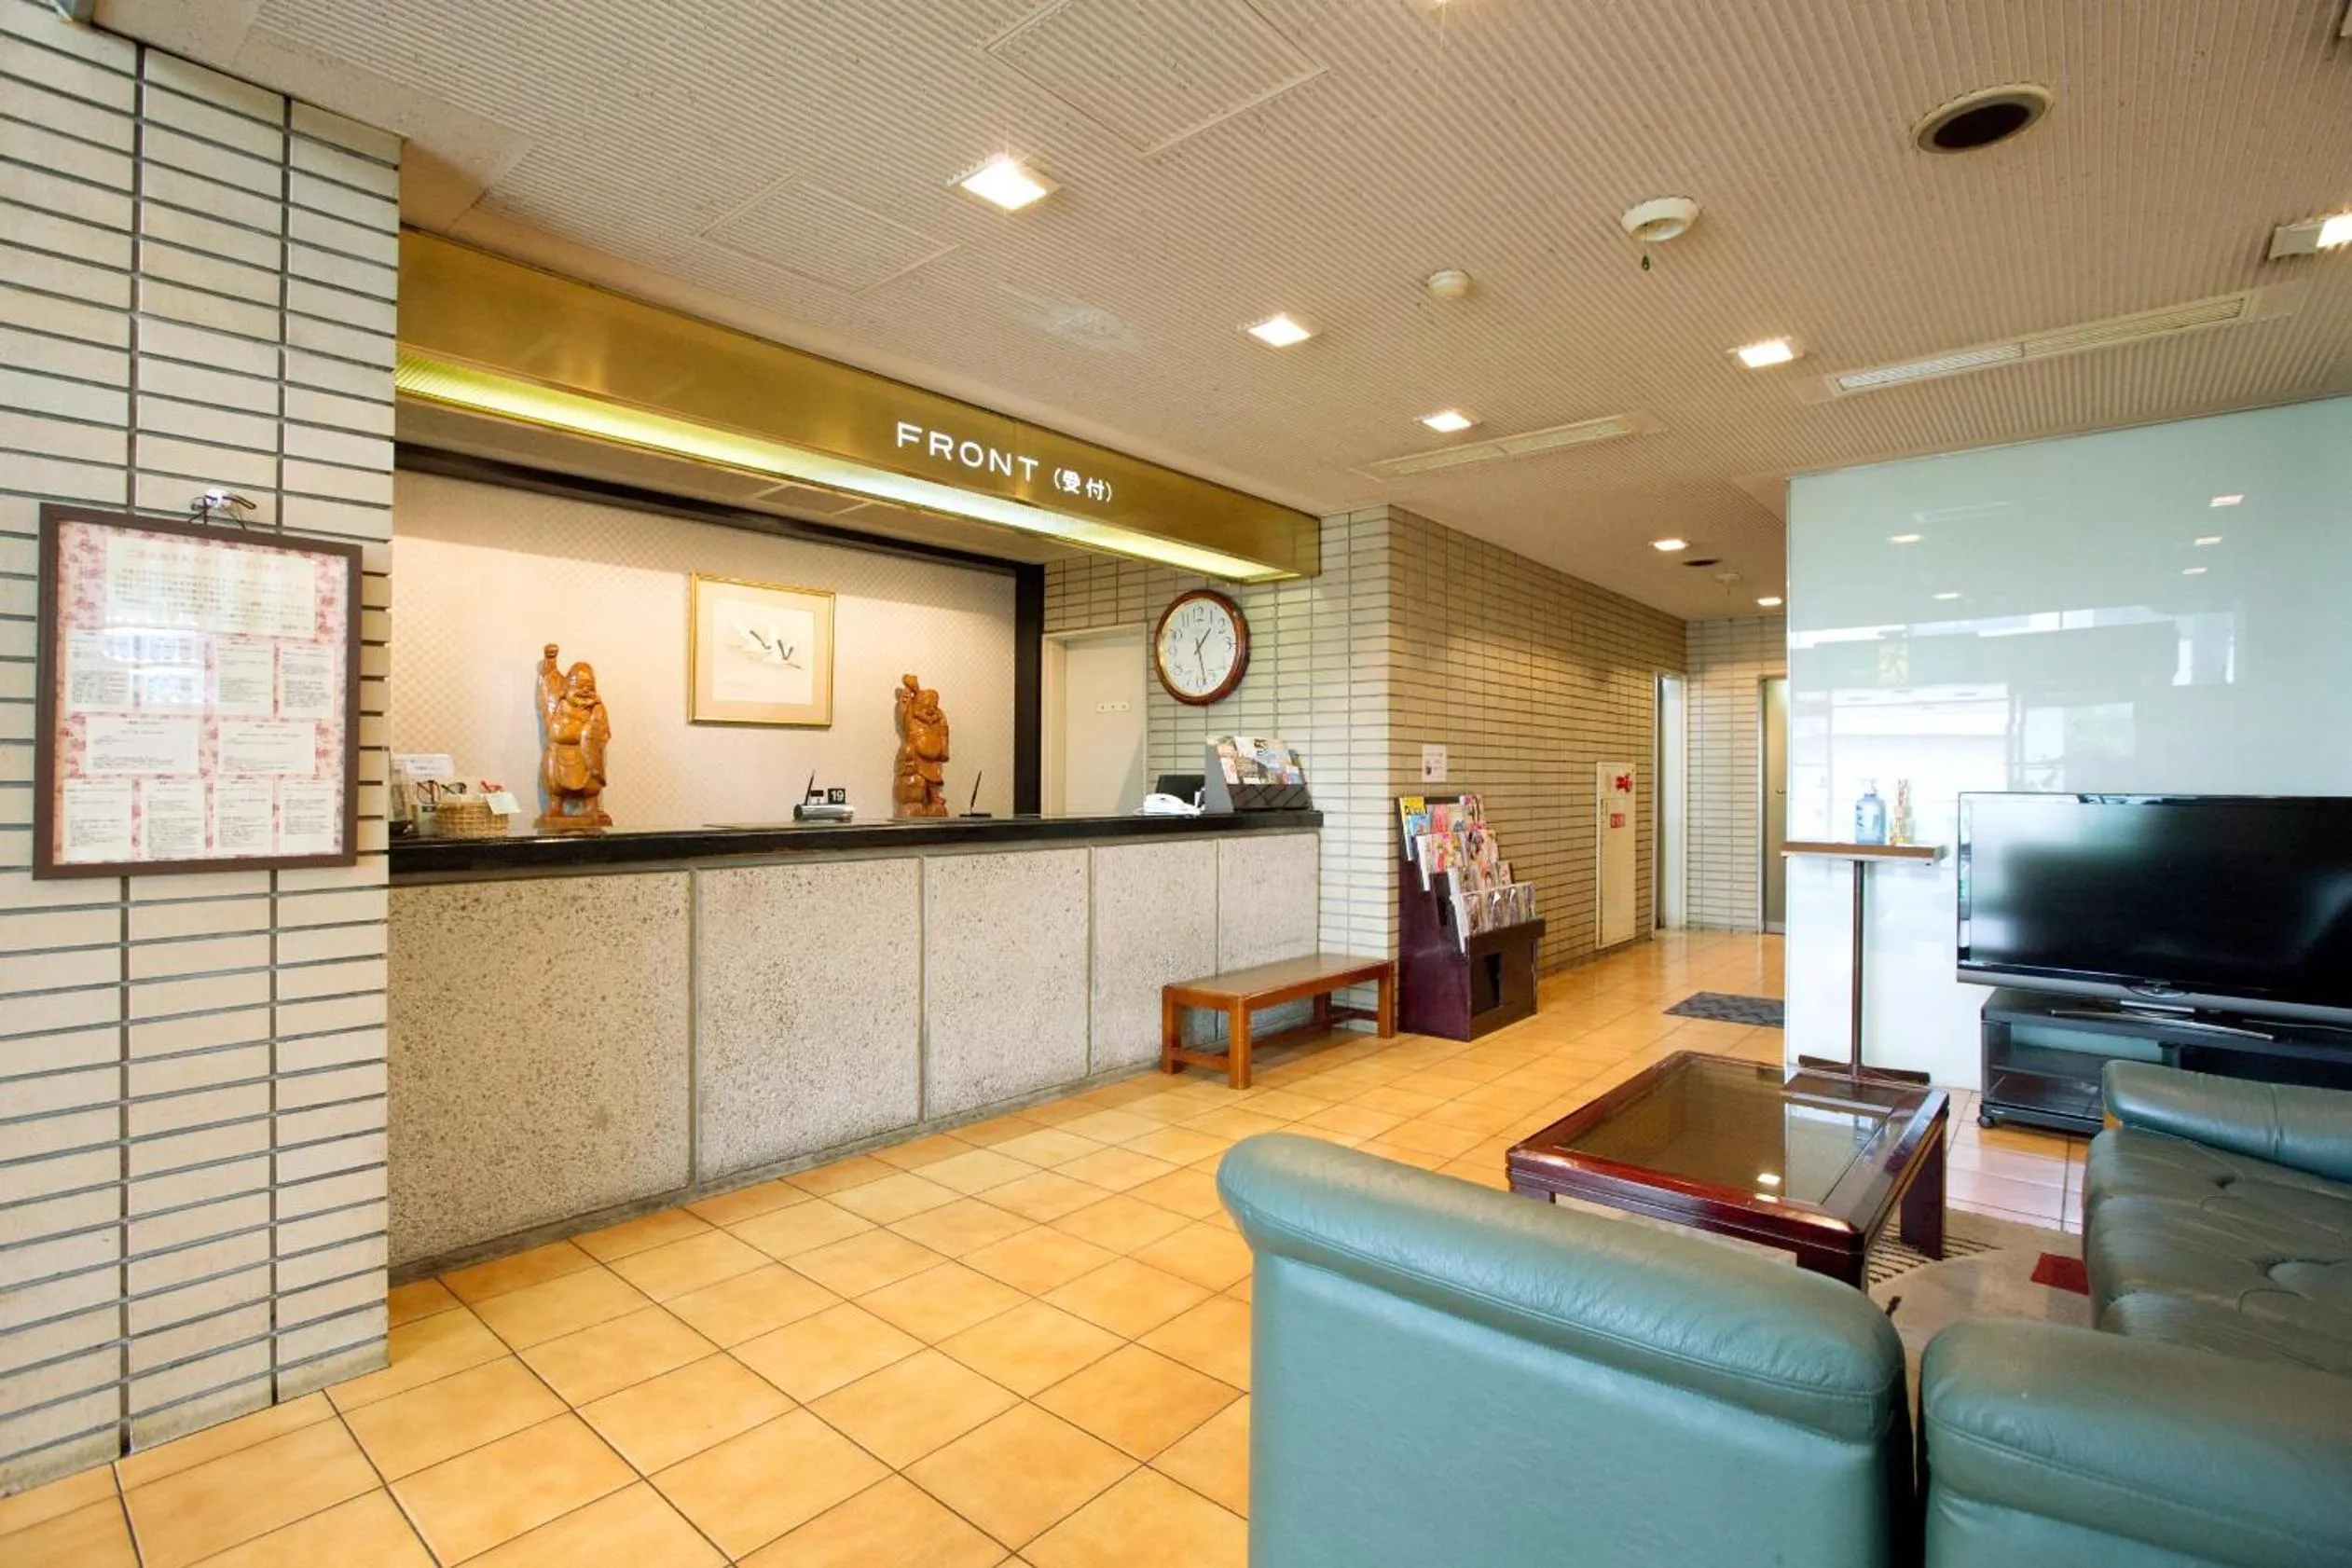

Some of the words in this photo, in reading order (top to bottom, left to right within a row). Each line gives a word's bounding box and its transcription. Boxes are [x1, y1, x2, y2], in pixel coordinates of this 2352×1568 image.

[897, 421, 1038, 482] FRONT
[1053, 468, 1112, 502] (受付)
[1192, 606, 1205, 624] 12
[1217, 616, 1227, 635] 2
[831, 790, 844, 802] 19
